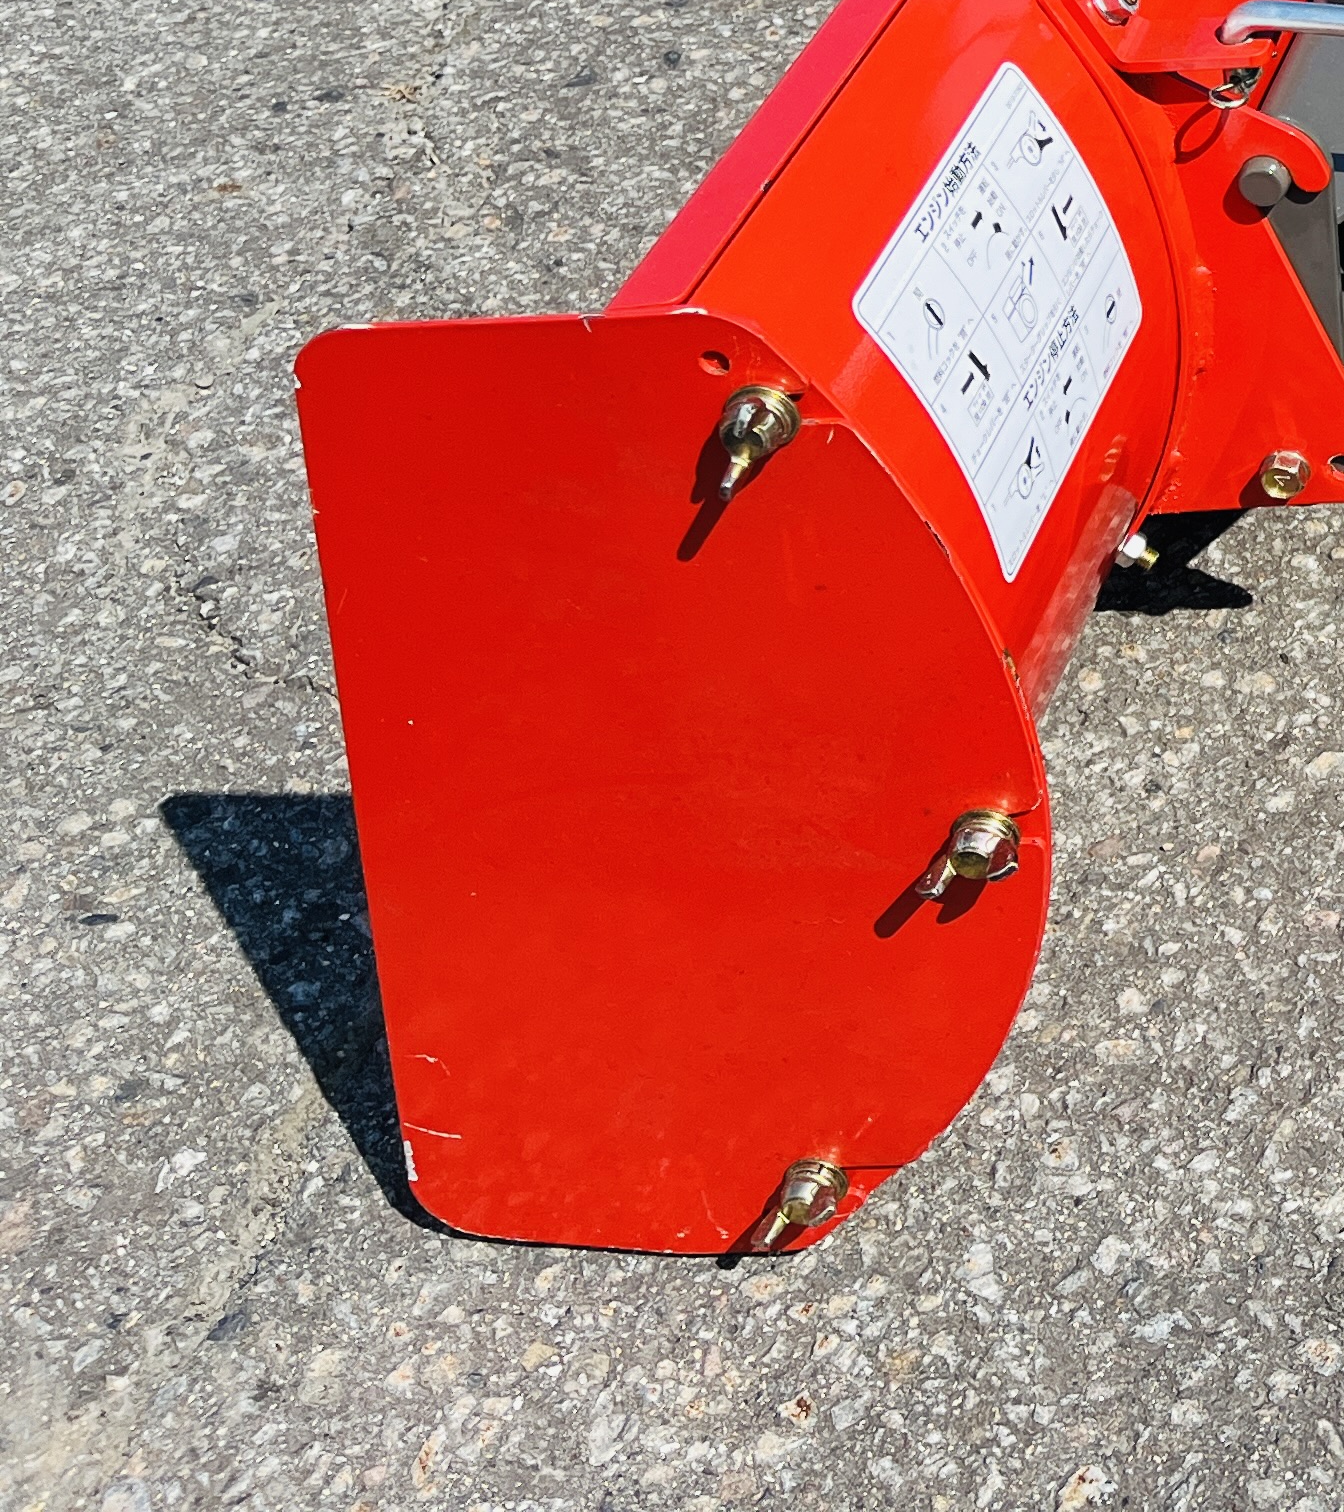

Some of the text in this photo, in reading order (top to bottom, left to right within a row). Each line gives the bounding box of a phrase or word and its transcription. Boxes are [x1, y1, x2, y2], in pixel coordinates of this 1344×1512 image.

[914, 140, 981, 243] エンジン始動方法
[1020, 302, 1080, 412] エンジン停止方法
